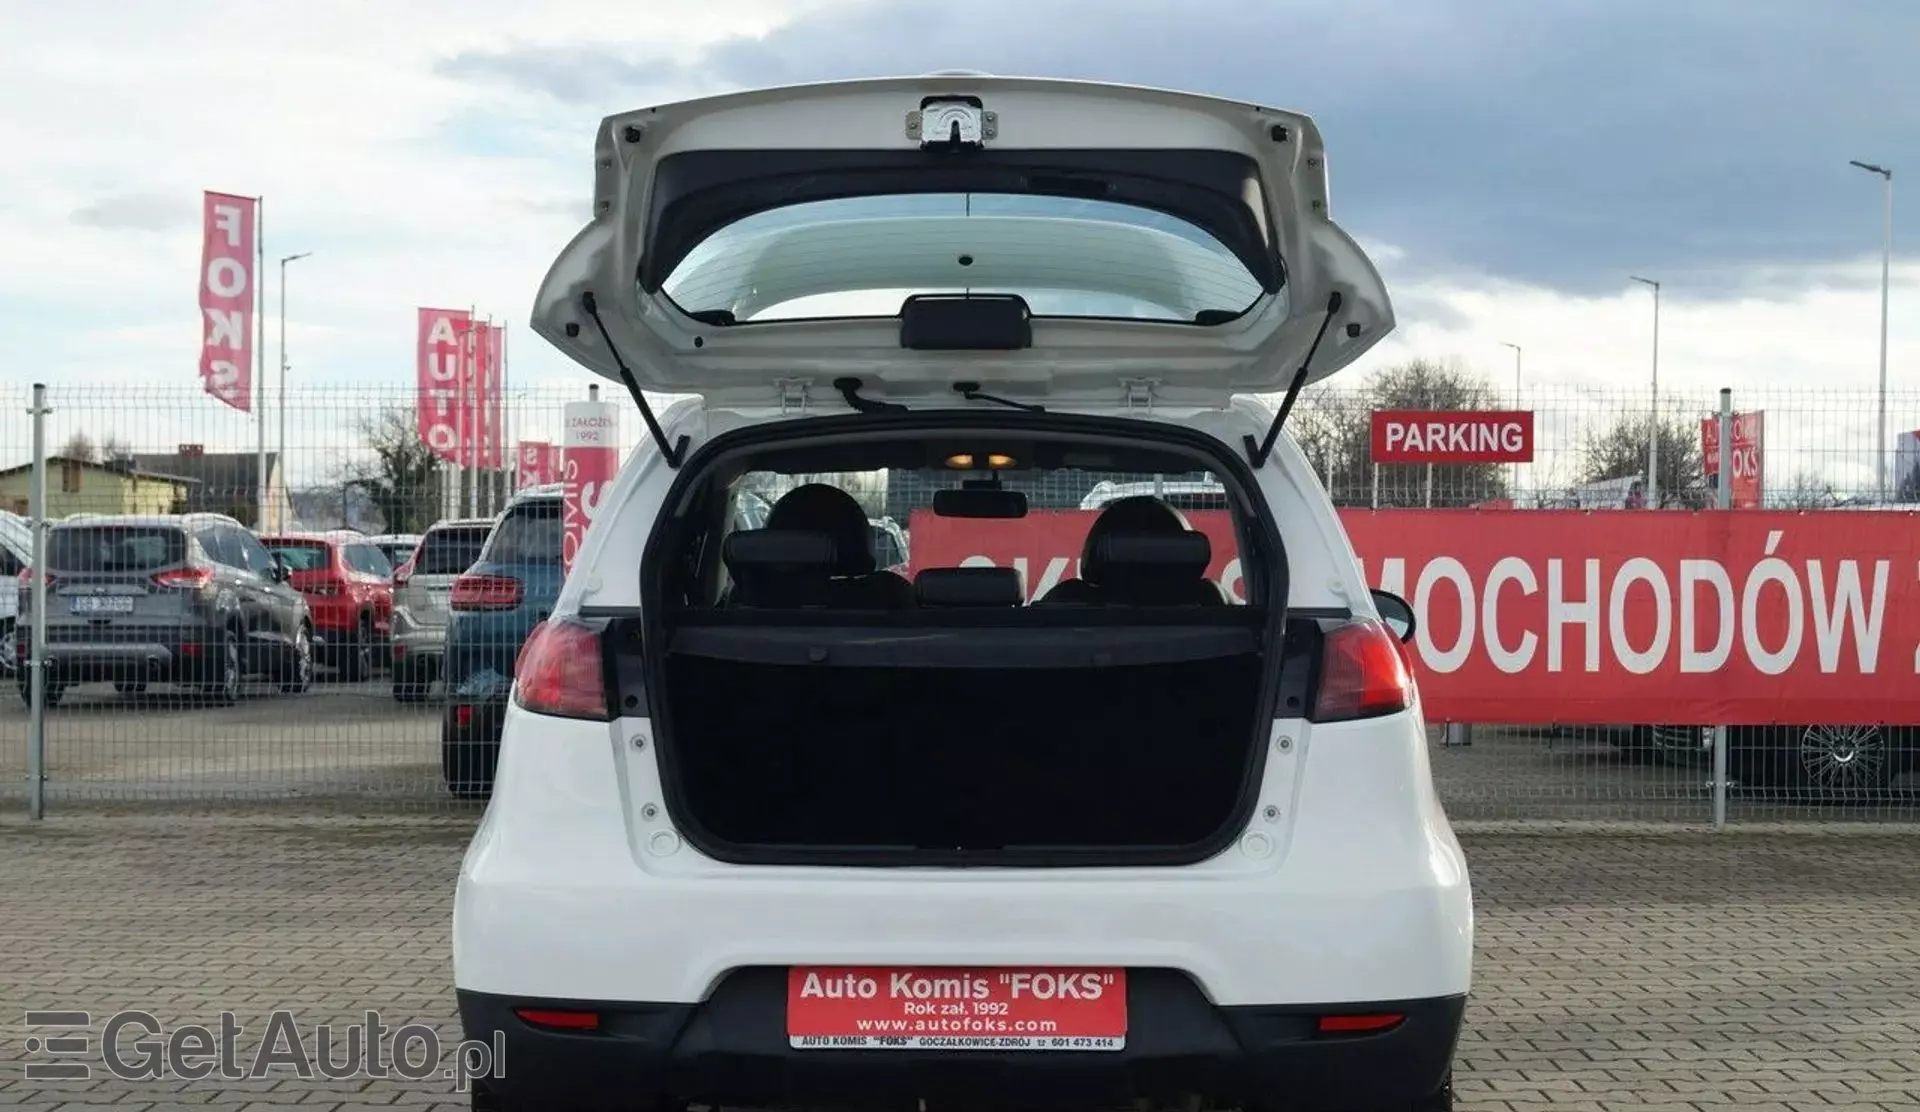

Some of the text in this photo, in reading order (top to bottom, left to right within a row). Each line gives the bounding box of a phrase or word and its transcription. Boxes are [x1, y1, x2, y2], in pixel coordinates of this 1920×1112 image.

[428, 317, 458, 449] AUTO
[1385, 422, 1524, 453] PARKING
[563, 459, 579, 578] OMIS
[1358, 530, 1890, 675] OCHODÓW
[800, 972, 1114, 1000] Auto Komis "FOKS"
[904, 1002, 1009, 1016] Rok zał. 1992
[856, 1017, 1057, 1032] www.autofoks.com
[802, 1036, 830, 1046] AUTO
[832, 1036, 867, 1046] KOMIS
[1051, 1038, 1072, 1047] 601
[1073, 1038, 1092, 1047] 473
[1094, 1038, 1114, 1047] 414
